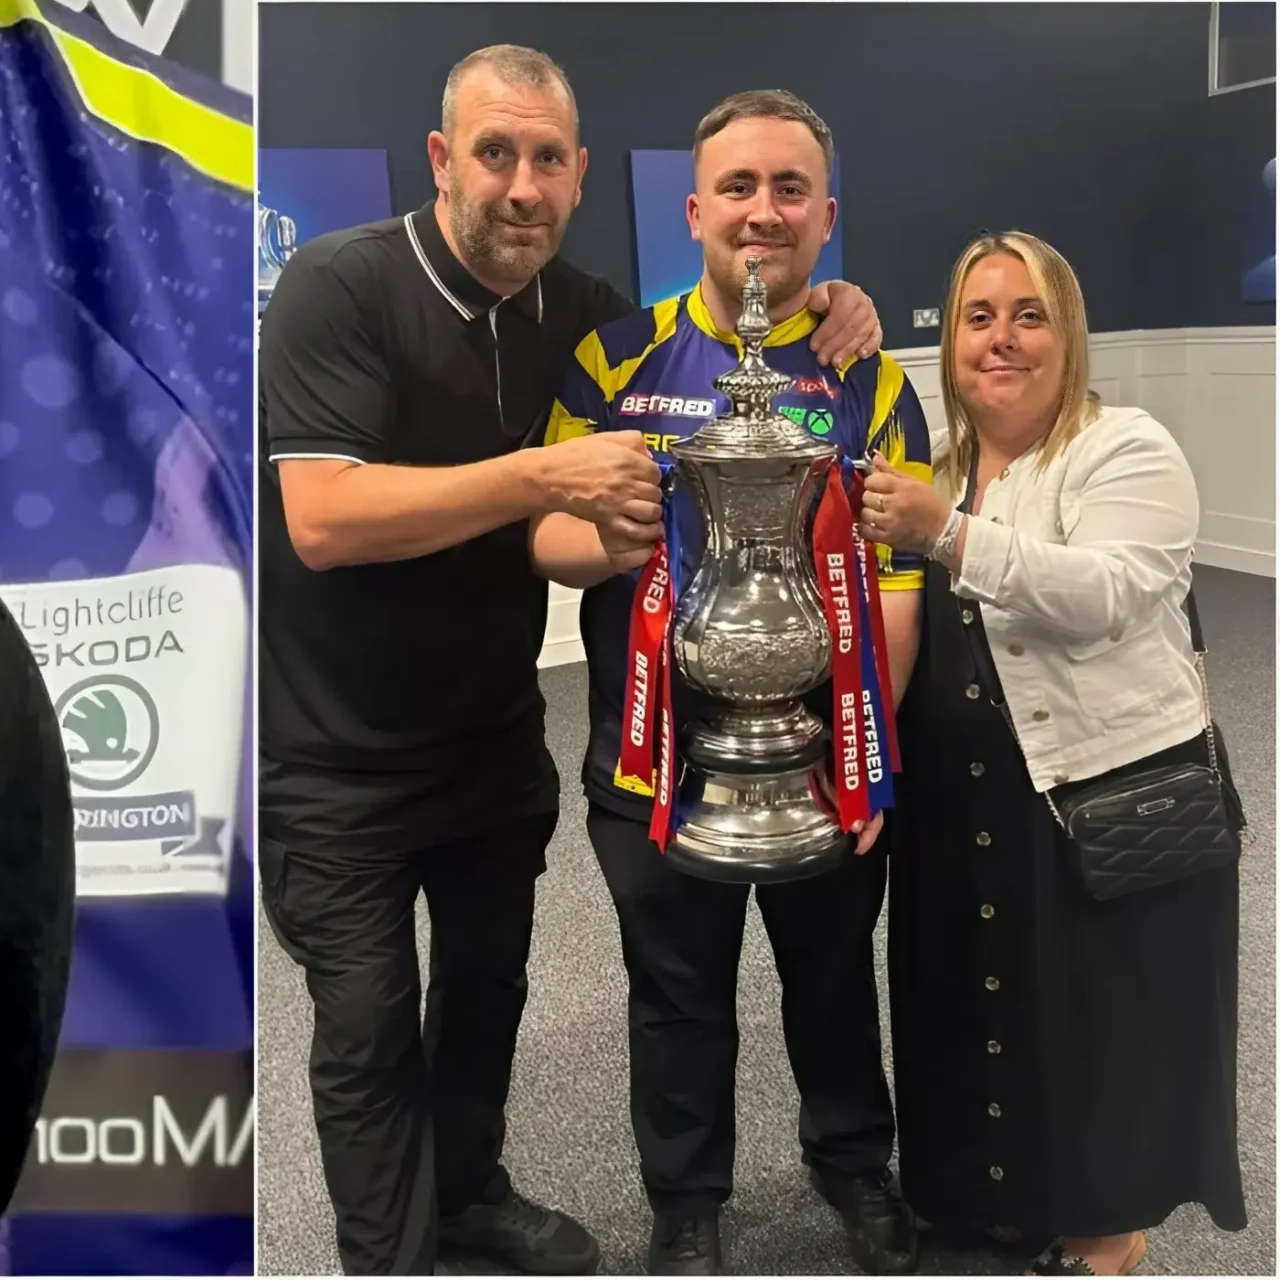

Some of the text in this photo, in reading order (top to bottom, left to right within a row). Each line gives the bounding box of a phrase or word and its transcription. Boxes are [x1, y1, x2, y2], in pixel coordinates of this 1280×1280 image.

[620, 395, 714, 417] BETFRED
[20, 584, 184, 637] Lightcliffe
[826, 552, 853, 653] BETFRED
[630, 650, 649, 747] BETFRED
[841, 692, 860, 791] BETFRED
[74, 801, 189, 832] RINGTON
